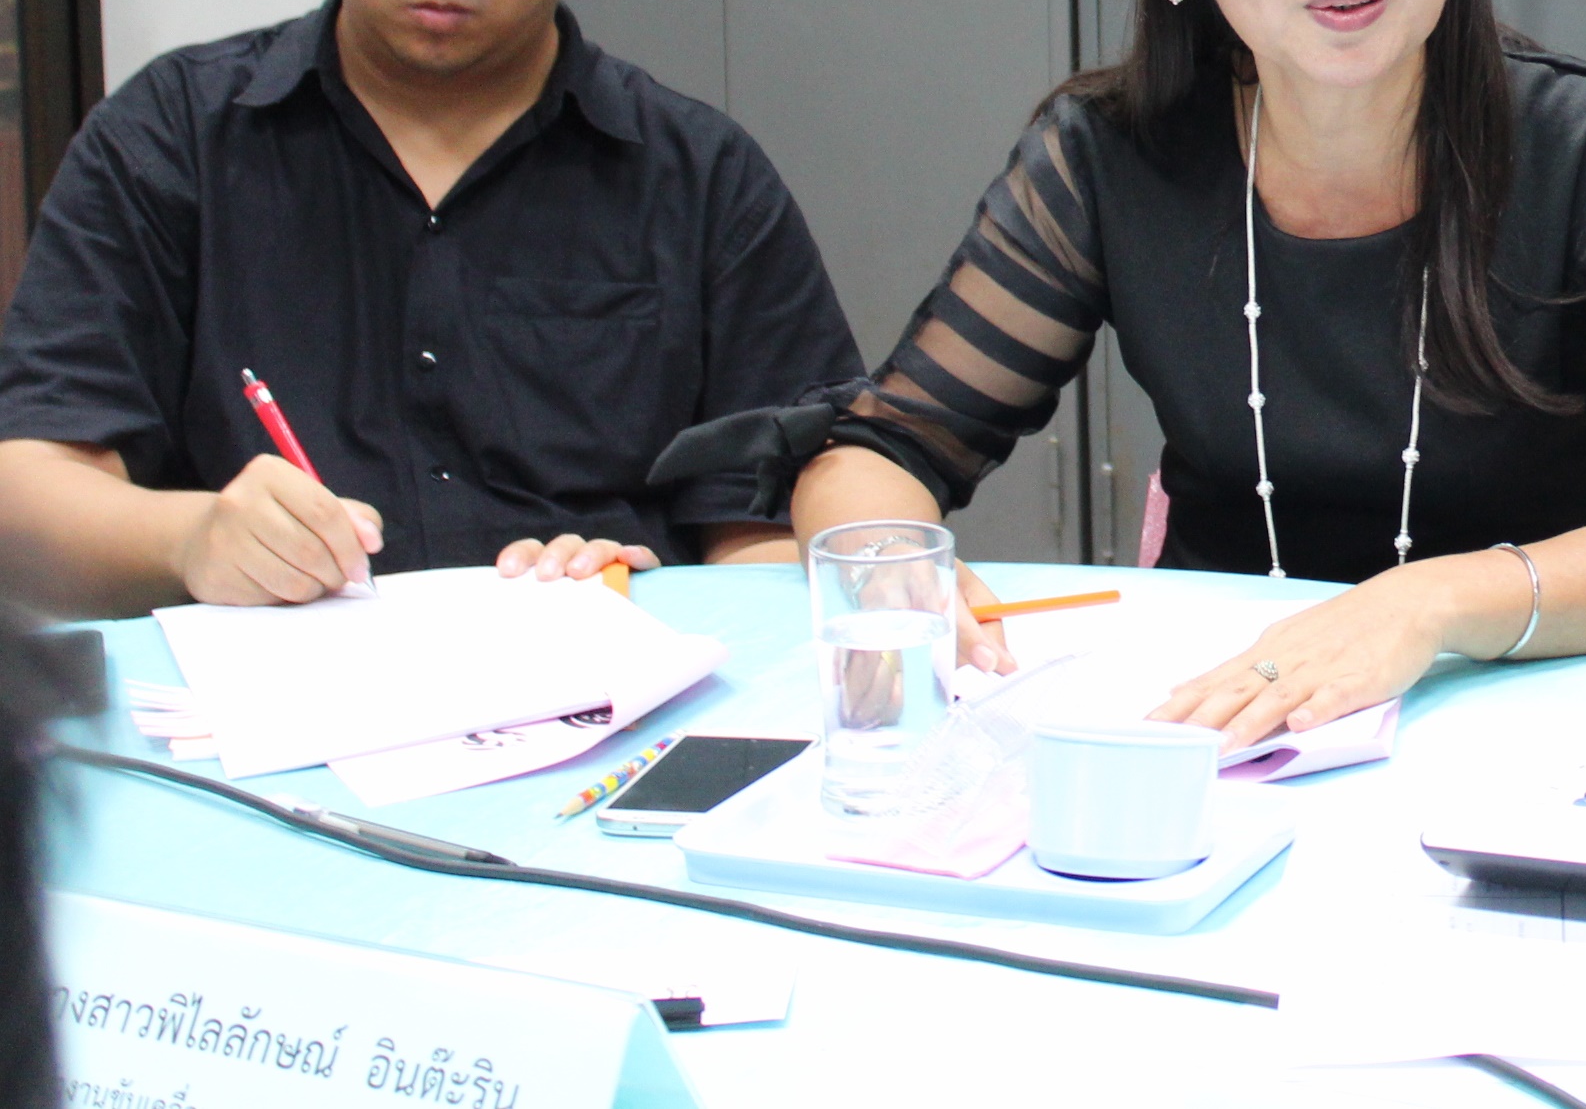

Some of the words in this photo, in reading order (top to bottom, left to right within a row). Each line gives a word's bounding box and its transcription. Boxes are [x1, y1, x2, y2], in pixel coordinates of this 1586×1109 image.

[52, 986, 349, 1079] างสาวพิไลลักษณ์
